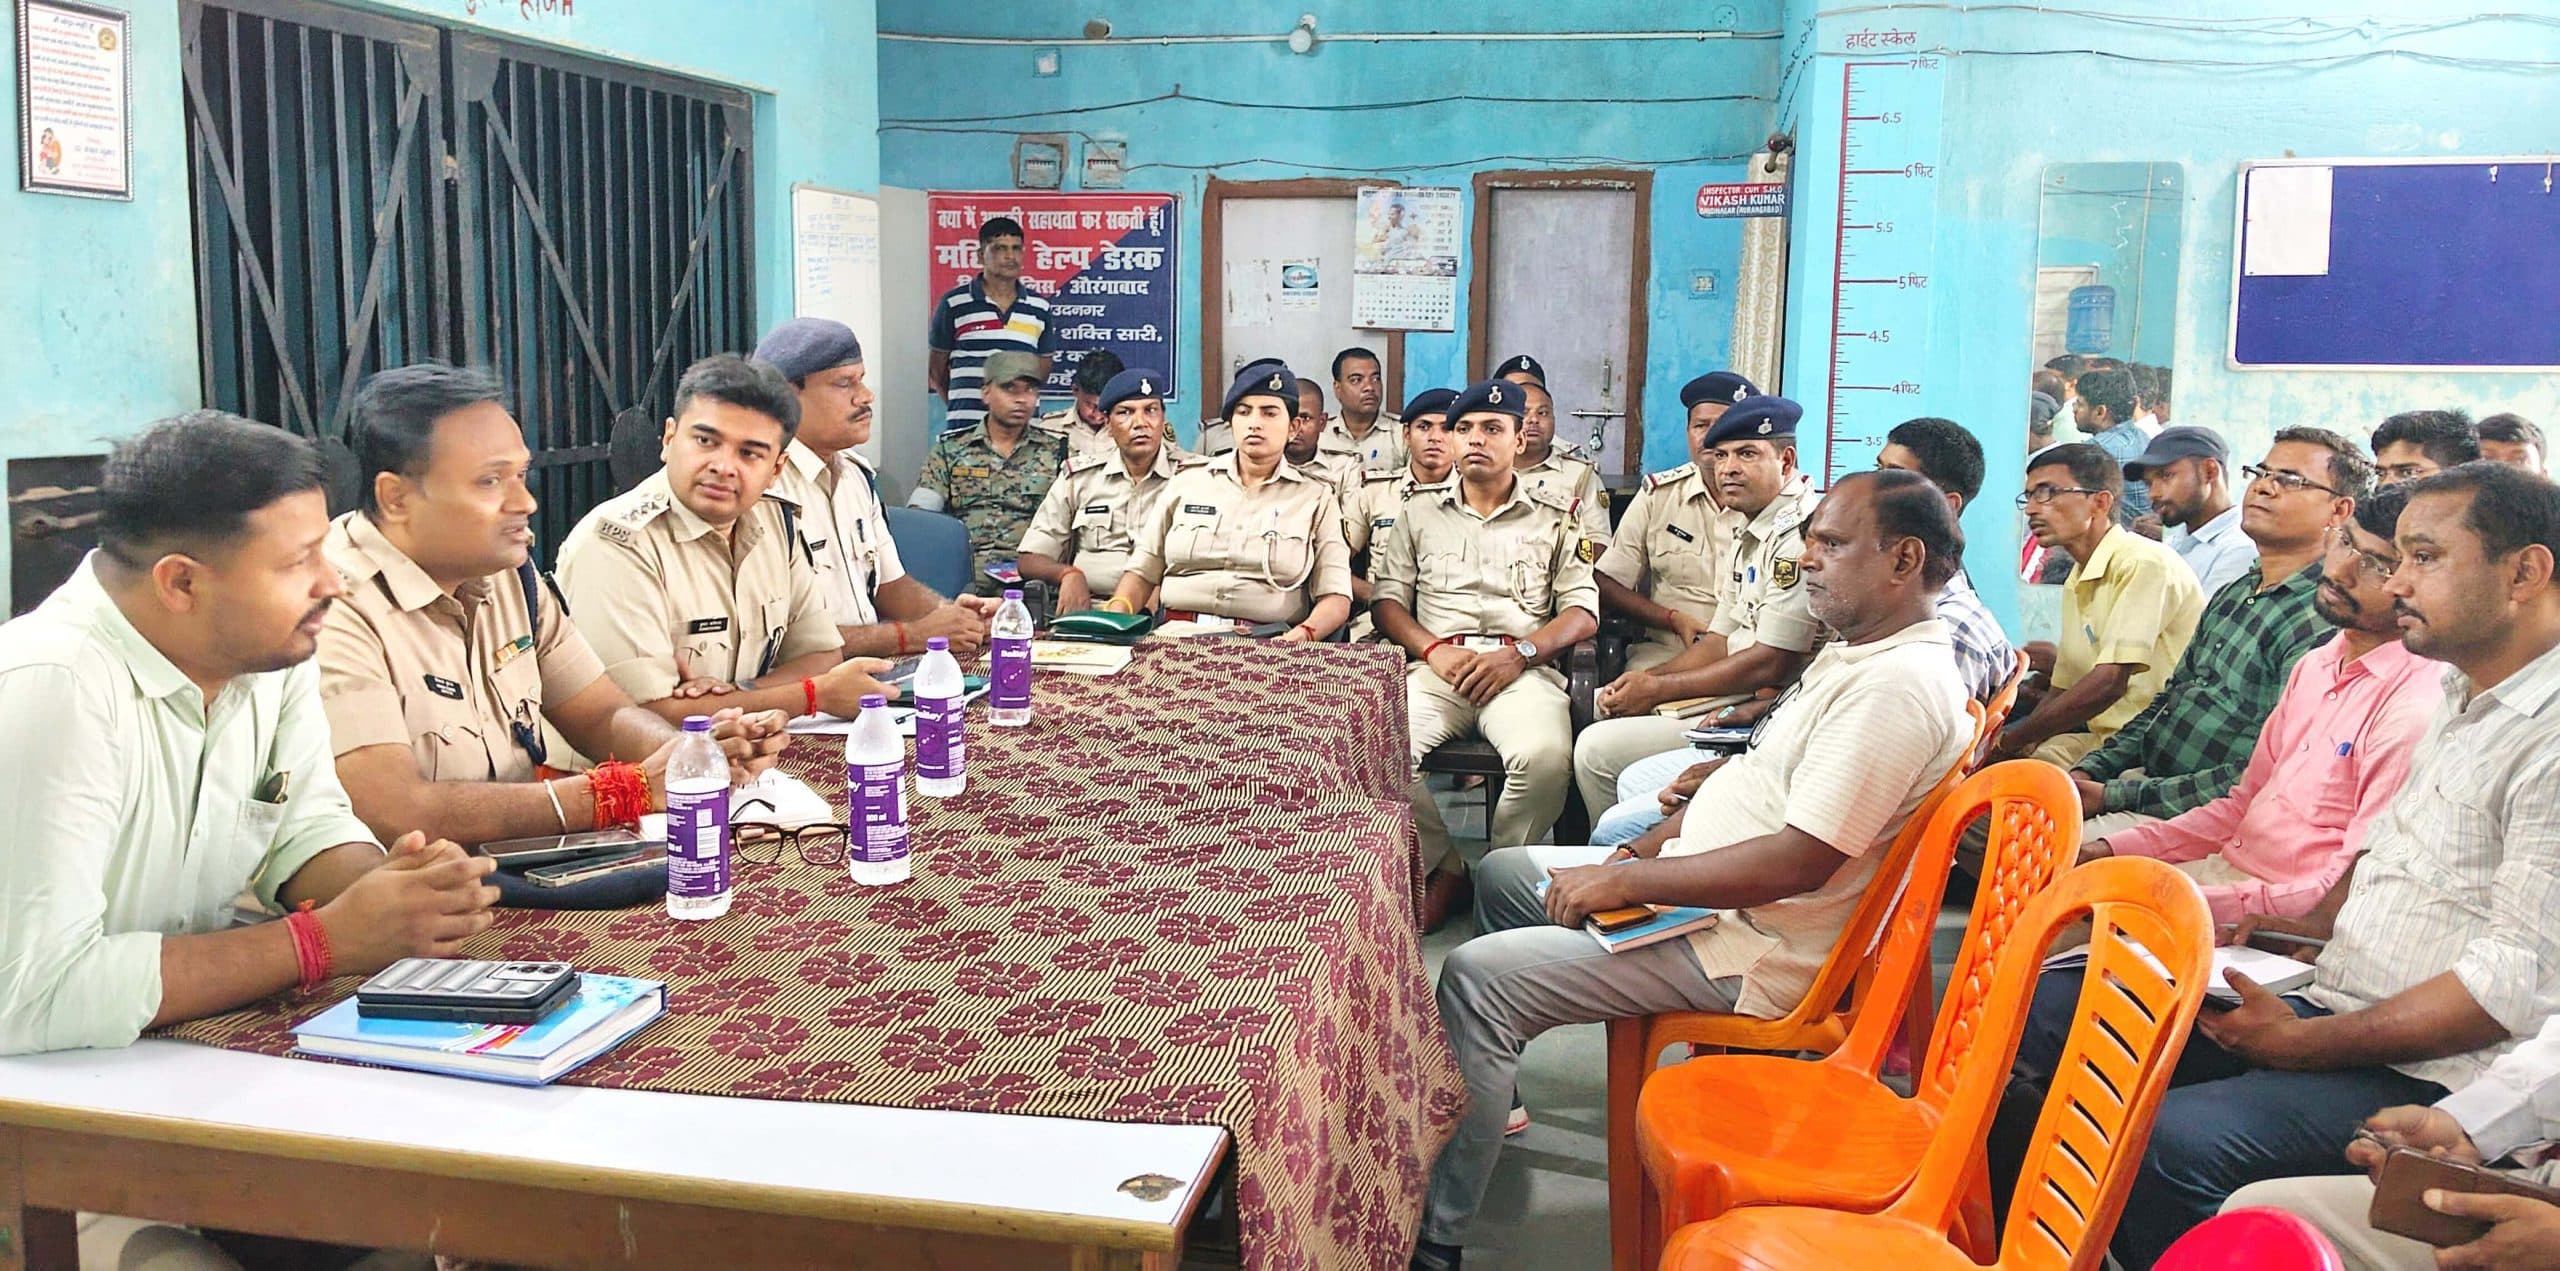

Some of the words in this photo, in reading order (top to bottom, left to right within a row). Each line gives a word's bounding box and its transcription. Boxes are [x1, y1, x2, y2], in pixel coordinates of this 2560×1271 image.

[1881, 28, 1916, 46] स्केल
[1882, 112, 1902, 124] 6.5
[1703, 186, 1740, 195] INSPECTOR
[1744, 186, 1760, 194] CUM
[1699, 195, 1747, 206] VIKASH
[1750, 194, 1785, 205] KUMAR
[937, 210, 962, 229] क्या
[1028, 210, 1078, 230] सहायता
[1081, 210, 1102, 230] कर
[1105, 206, 1145, 230] सकती
[1876, 222, 1893, 233] 5.5
[1032, 240, 1093, 270] हेल्प
[1100, 240, 1165, 271] डेस्क
[1069, 276, 1150, 296] औरंगाबाद
[1061, 323, 1111, 341] शक्ति
[1868, 330, 1890, 343] 4.5
[1865, 436, 1882, 446] 3.5
